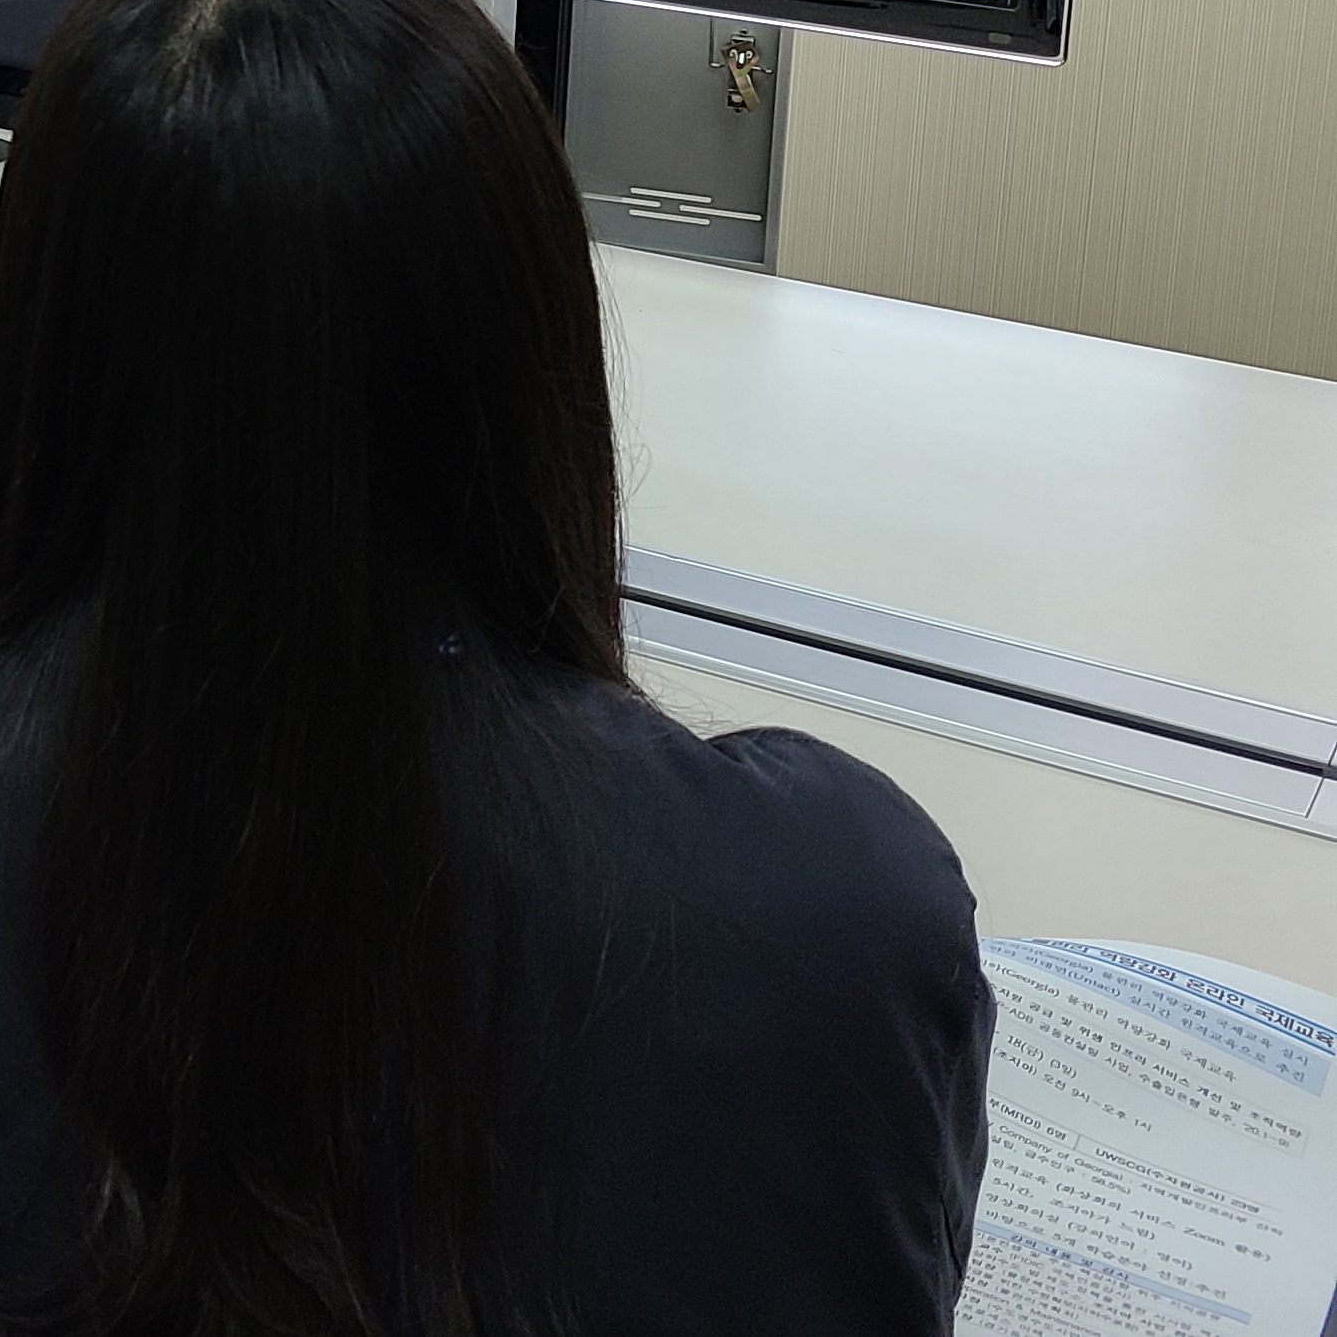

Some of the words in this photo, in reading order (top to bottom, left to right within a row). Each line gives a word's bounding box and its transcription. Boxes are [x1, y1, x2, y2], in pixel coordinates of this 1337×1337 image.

[1184, 977, 1246, 1010] 온라인
[1254, 1004, 1335, 1049] 국제교육
[998, 1124, 1054, 1155] Company
[1056, 1151, 1071, 1161] of
[1074, 1157, 1125, 1183] Georgia)
[1182, 1226, 1227, 1248] Zoom
